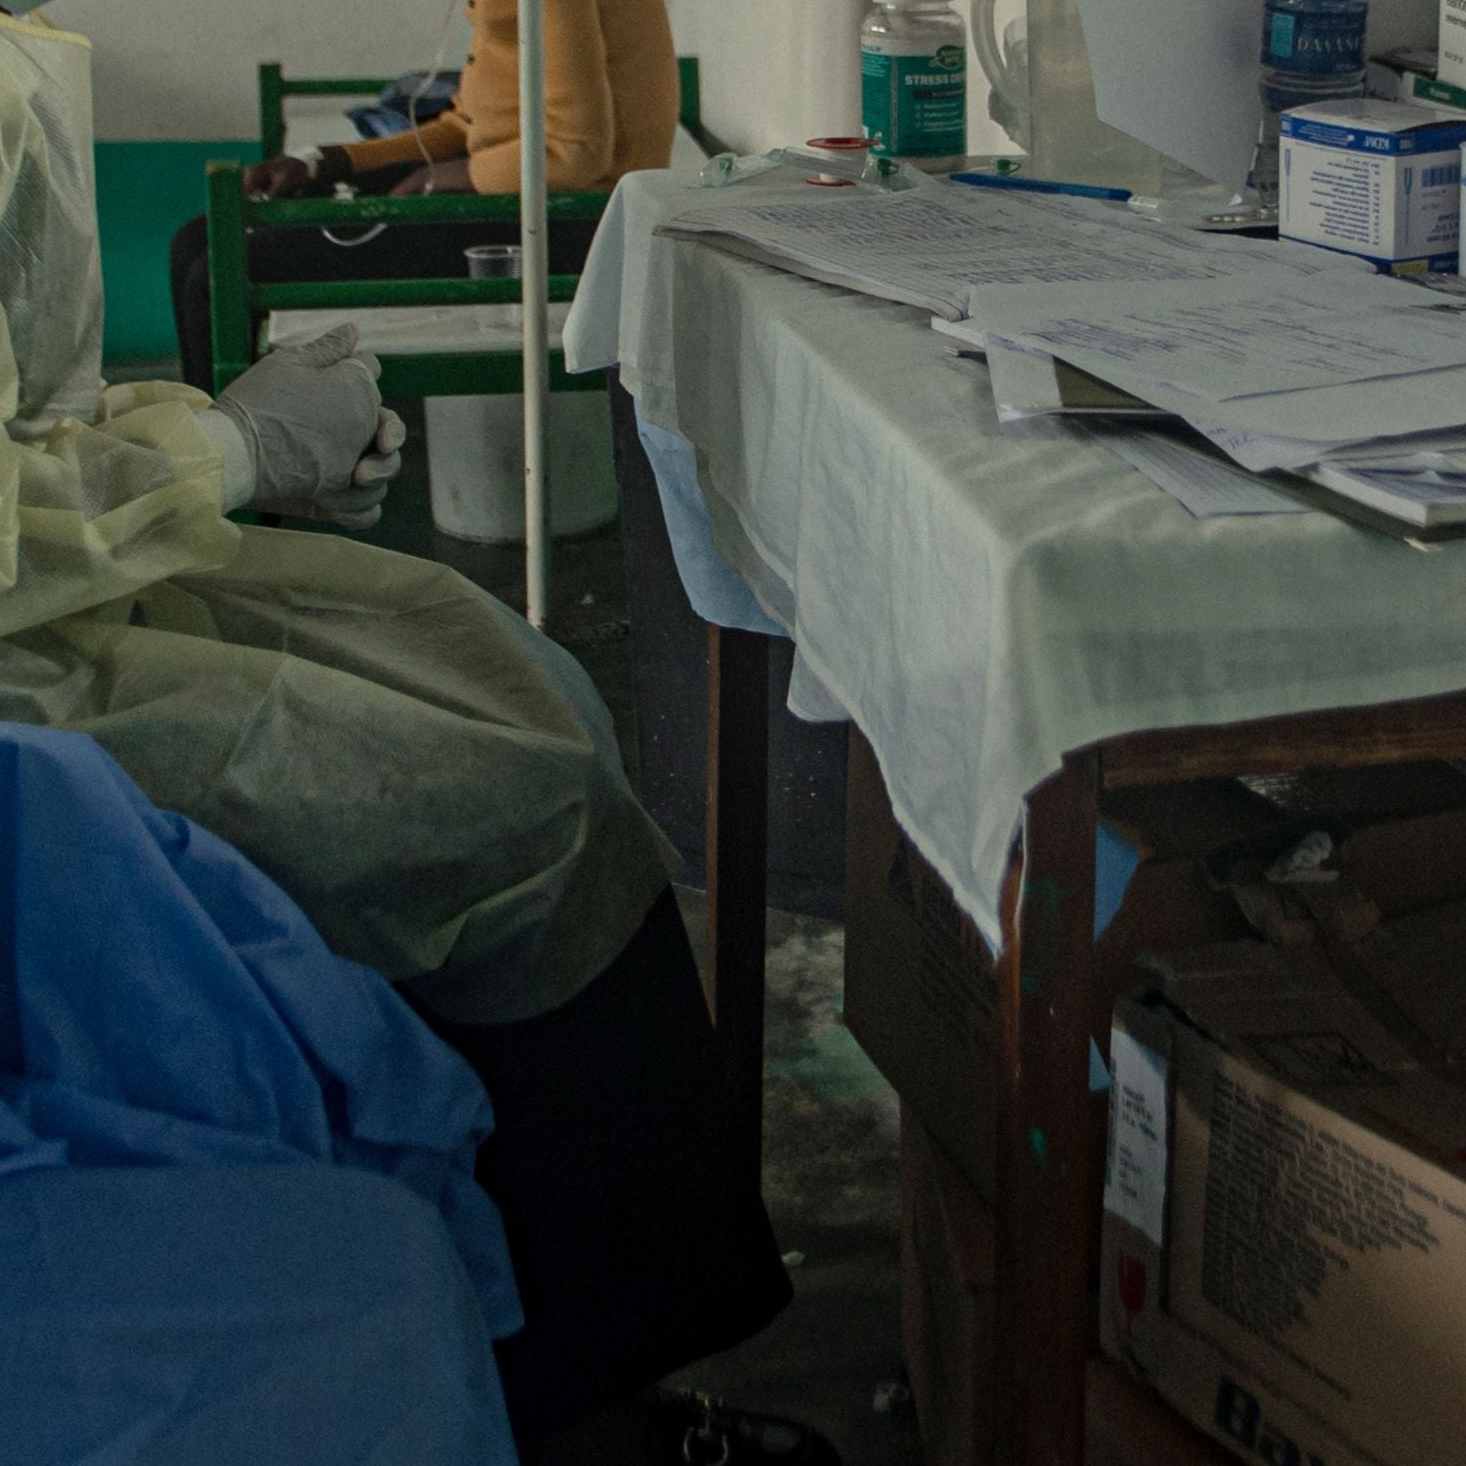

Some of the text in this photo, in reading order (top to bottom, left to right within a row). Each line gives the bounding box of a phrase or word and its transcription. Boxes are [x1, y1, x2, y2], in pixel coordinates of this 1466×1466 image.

[904, 74, 949, 86] STRESS
[1364, 135, 1391, 151] KDM
[1214, 1377, 1326, 1466] Ba
